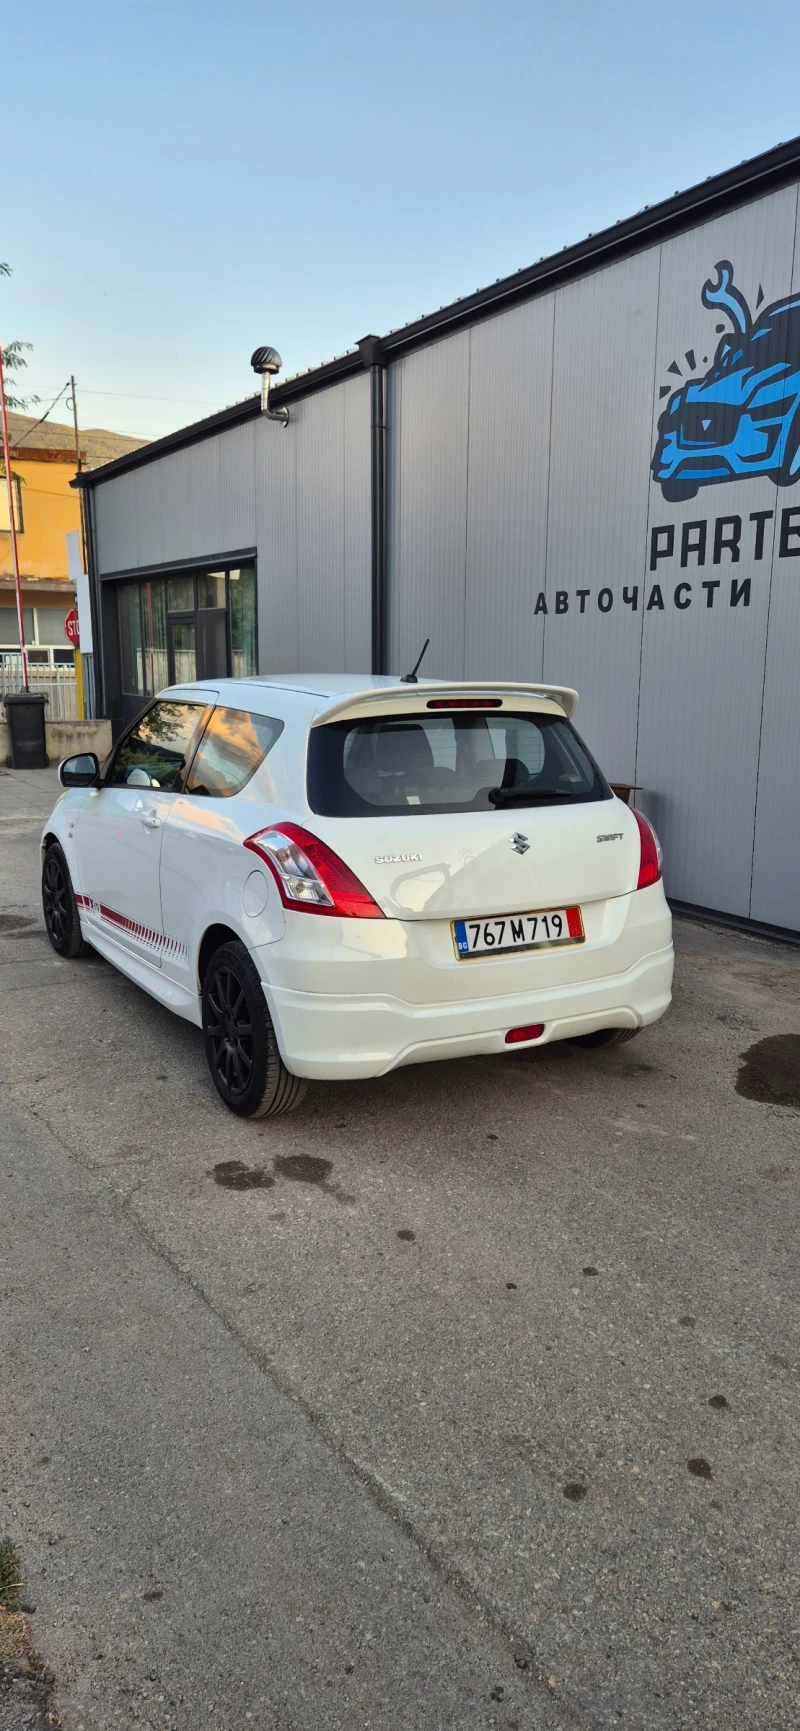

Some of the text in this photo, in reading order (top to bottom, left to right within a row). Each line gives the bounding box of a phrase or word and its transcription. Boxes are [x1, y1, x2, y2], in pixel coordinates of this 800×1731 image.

[534, 578, 752, 615] АВТОЧАСТИ
[596, 832, 624, 843] SWIFT
[374, 853, 423, 865] SUZUKI
[458, 942, 468, 950] BG
